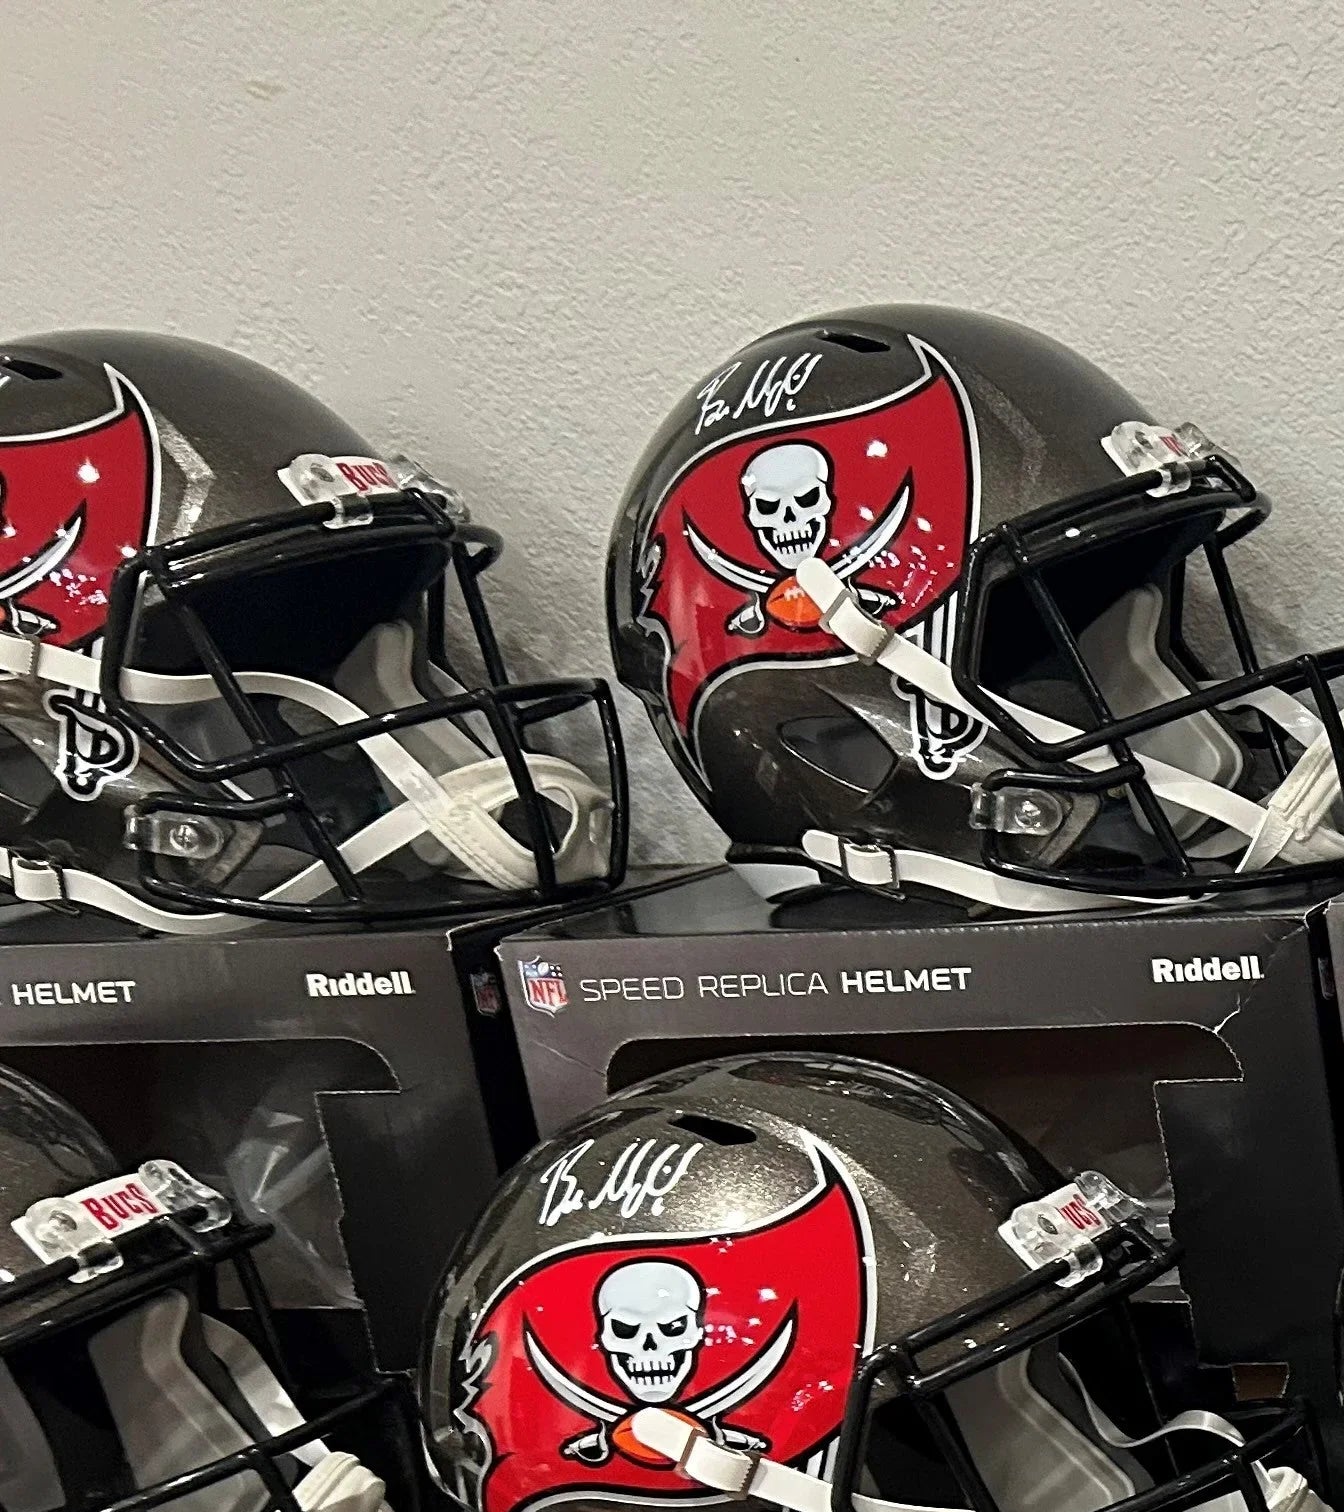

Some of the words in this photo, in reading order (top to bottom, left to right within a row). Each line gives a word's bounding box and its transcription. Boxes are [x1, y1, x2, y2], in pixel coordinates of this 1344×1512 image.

[335, 462, 397, 492] BUCS
[1151, 955, 1265, 983] Riddell
[11, 980, 136, 1006] HELMET
[305, 971, 416, 997] Riddell
[530, 979, 568, 1006] NFL
[579, 976, 685, 1002] SPEED
[697, 972, 829, 998] REPLICA
[841, 967, 972, 994] HELMET
[80, 1182, 159, 1231] BUCS
[1060, 1193, 1102, 1230] UCS
